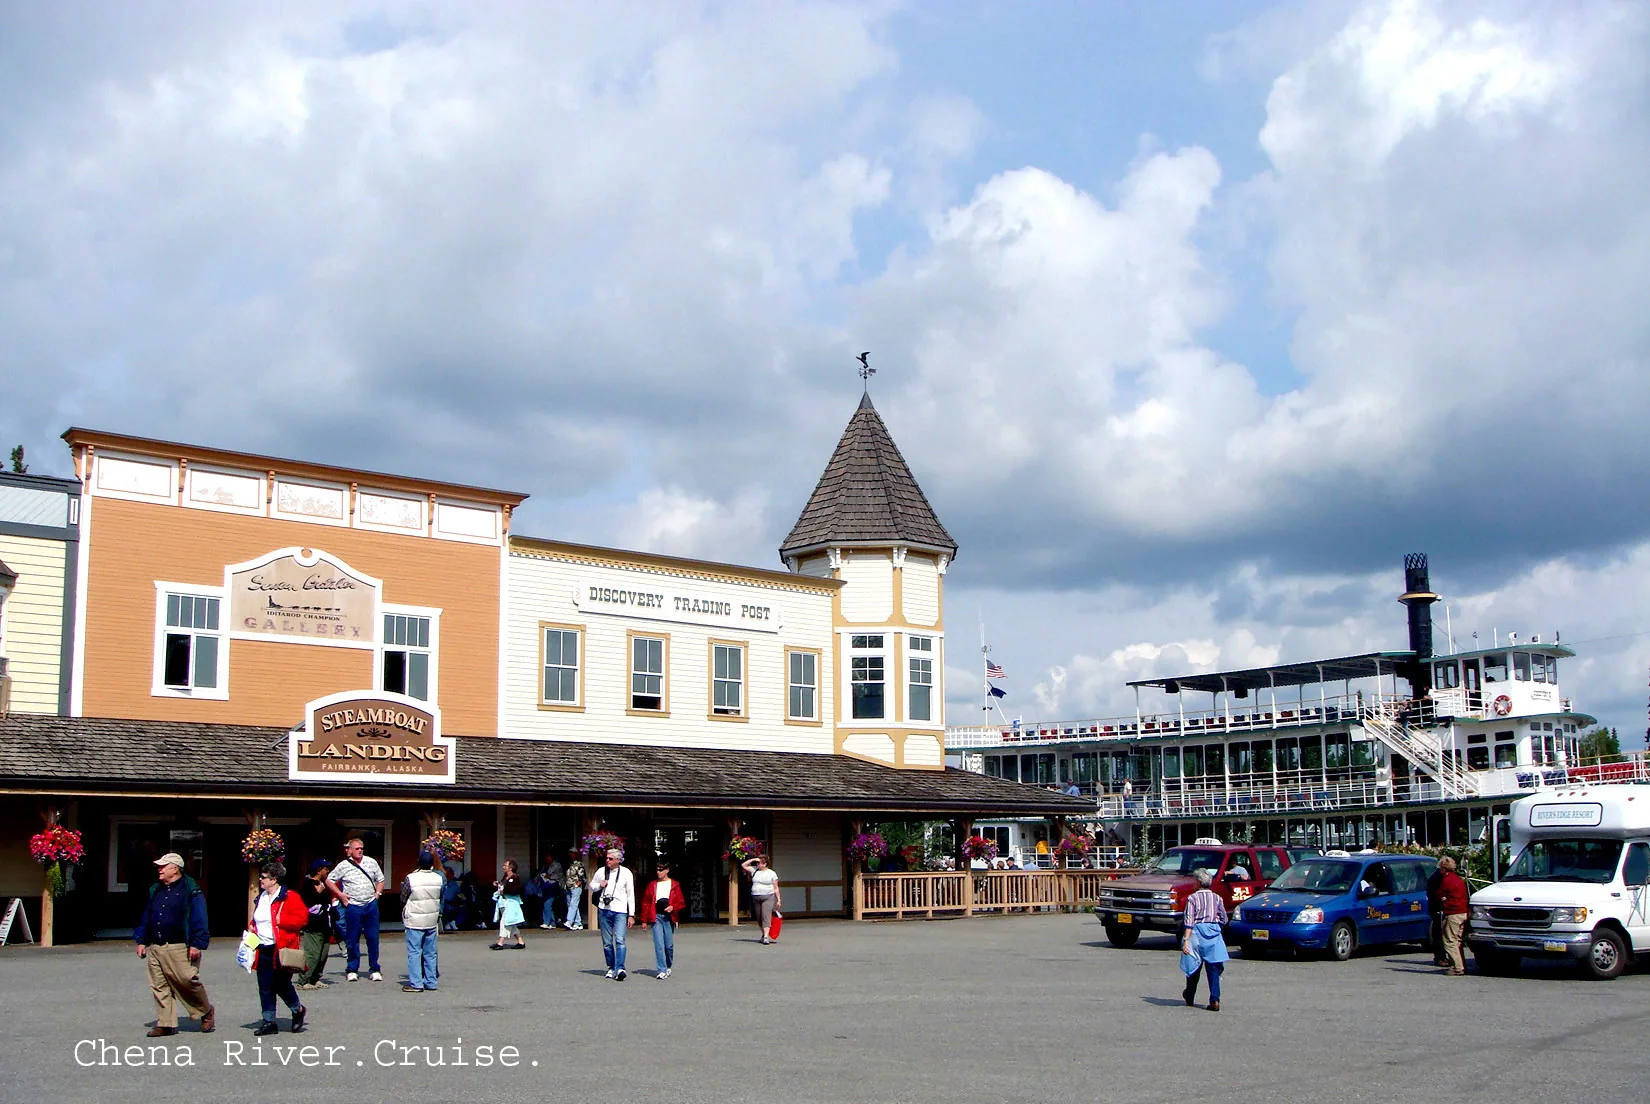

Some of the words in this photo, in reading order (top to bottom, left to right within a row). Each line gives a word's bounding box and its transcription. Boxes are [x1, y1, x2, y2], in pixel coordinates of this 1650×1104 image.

[589, 586, 664, 608] DISCOVERY
[673, 596, 731, 616] TRADING
[741, 604, 771, 620] POST
[266, 610, 302, 619] IDITAROD
[303, 614, 341, 622] CHAMPION
[243, 617, 361, 637] GALLERY
[321, 708, 428, 735] STEAMBOAT
[299, 741, 446, 763] LANDING
[386, 765, 424, 773] ALASKA
[1556, 811, 1572, 819] EDGE
[1572, 810, 1595, 819] RESORT
